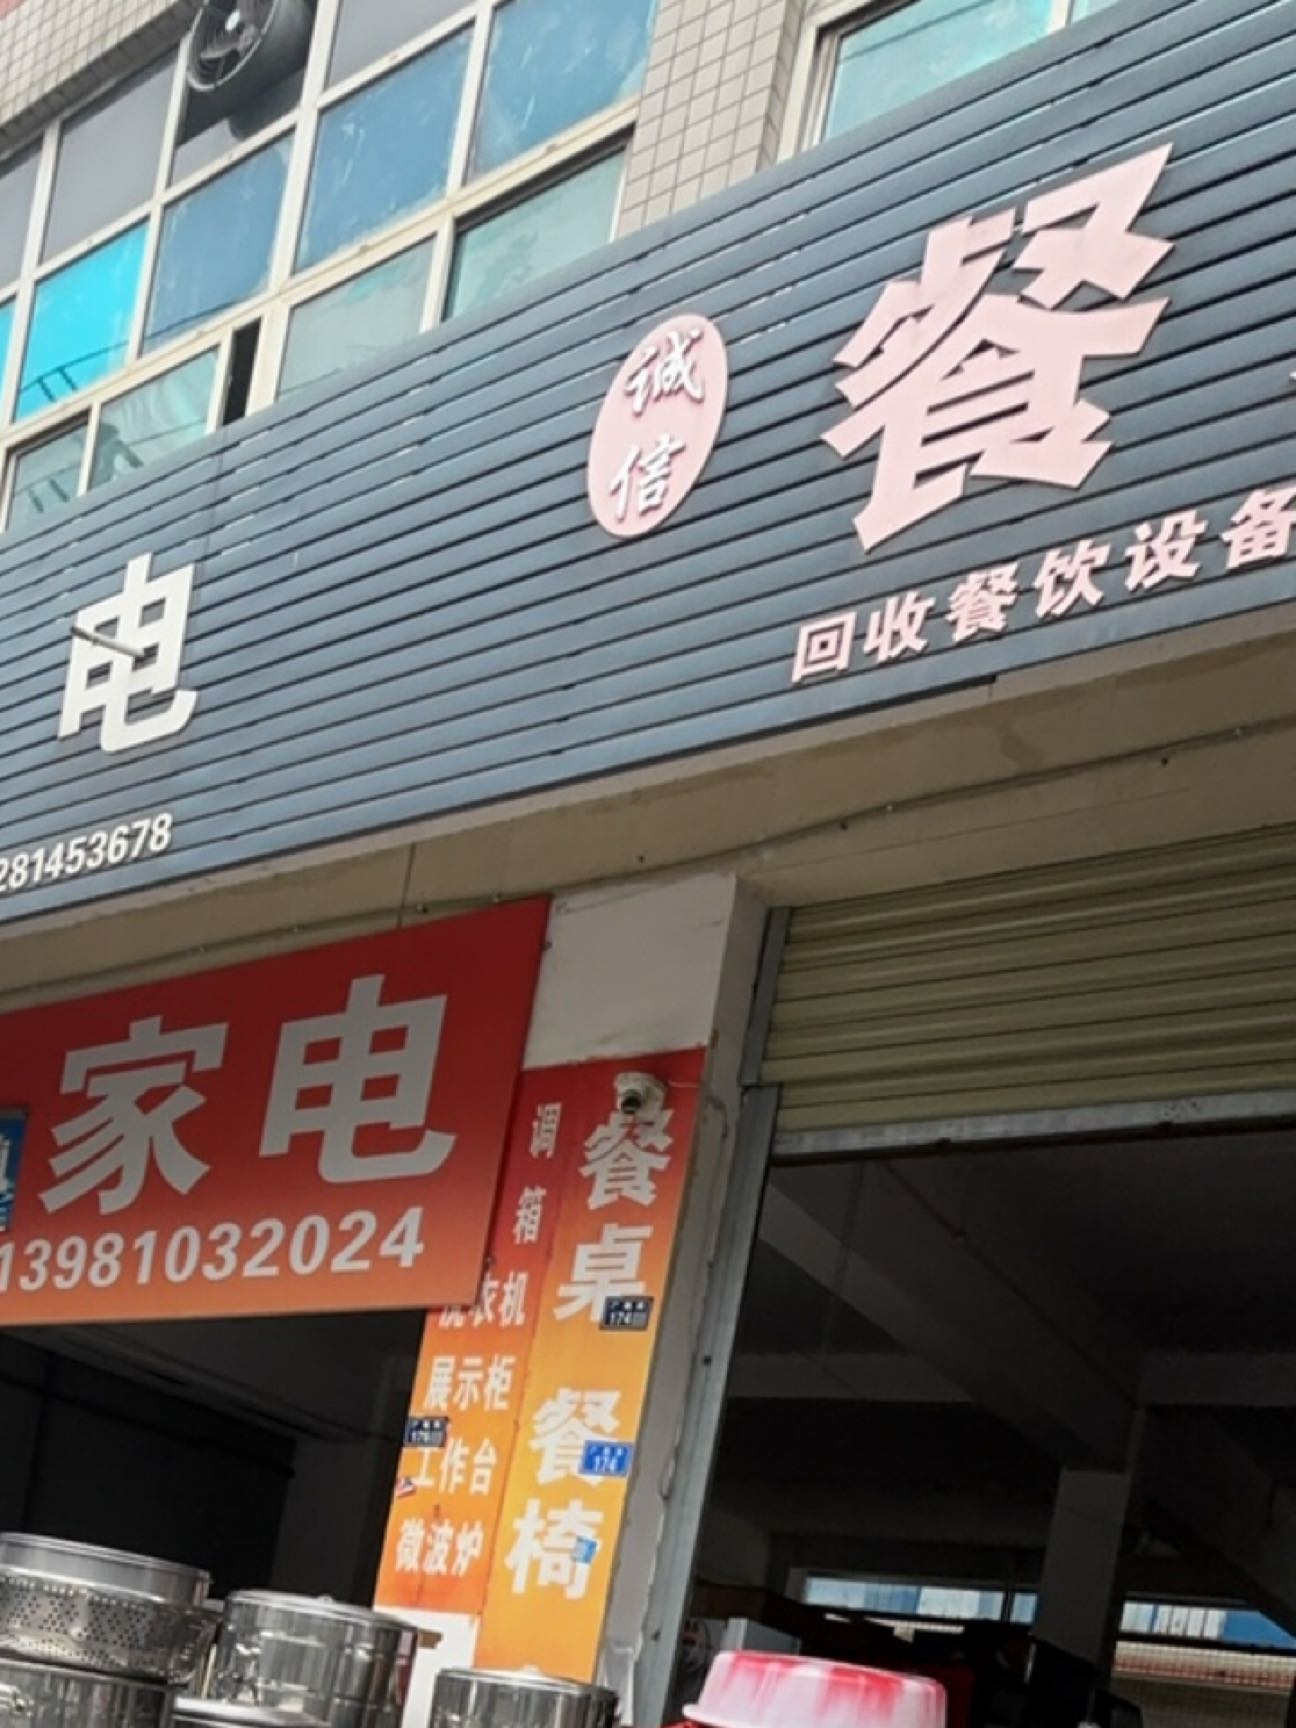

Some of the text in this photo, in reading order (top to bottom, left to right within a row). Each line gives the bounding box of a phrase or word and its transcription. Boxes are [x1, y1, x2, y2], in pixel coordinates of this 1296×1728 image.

[610, 328, 703, 524] 诚信
[821, 141, 1175, 554] 餐
[790, 485, 1296, 684] 回收餐饮设备
[38, 973, 457, 1215] 家电
[422, 1352, 517, 1412] 展示柜
[505, 1105, 675, 1600] 餐桌 餐椅
[394, 1516, 485, 1578] 微波炉
[412, 1433, 498, 1496] 工作台
